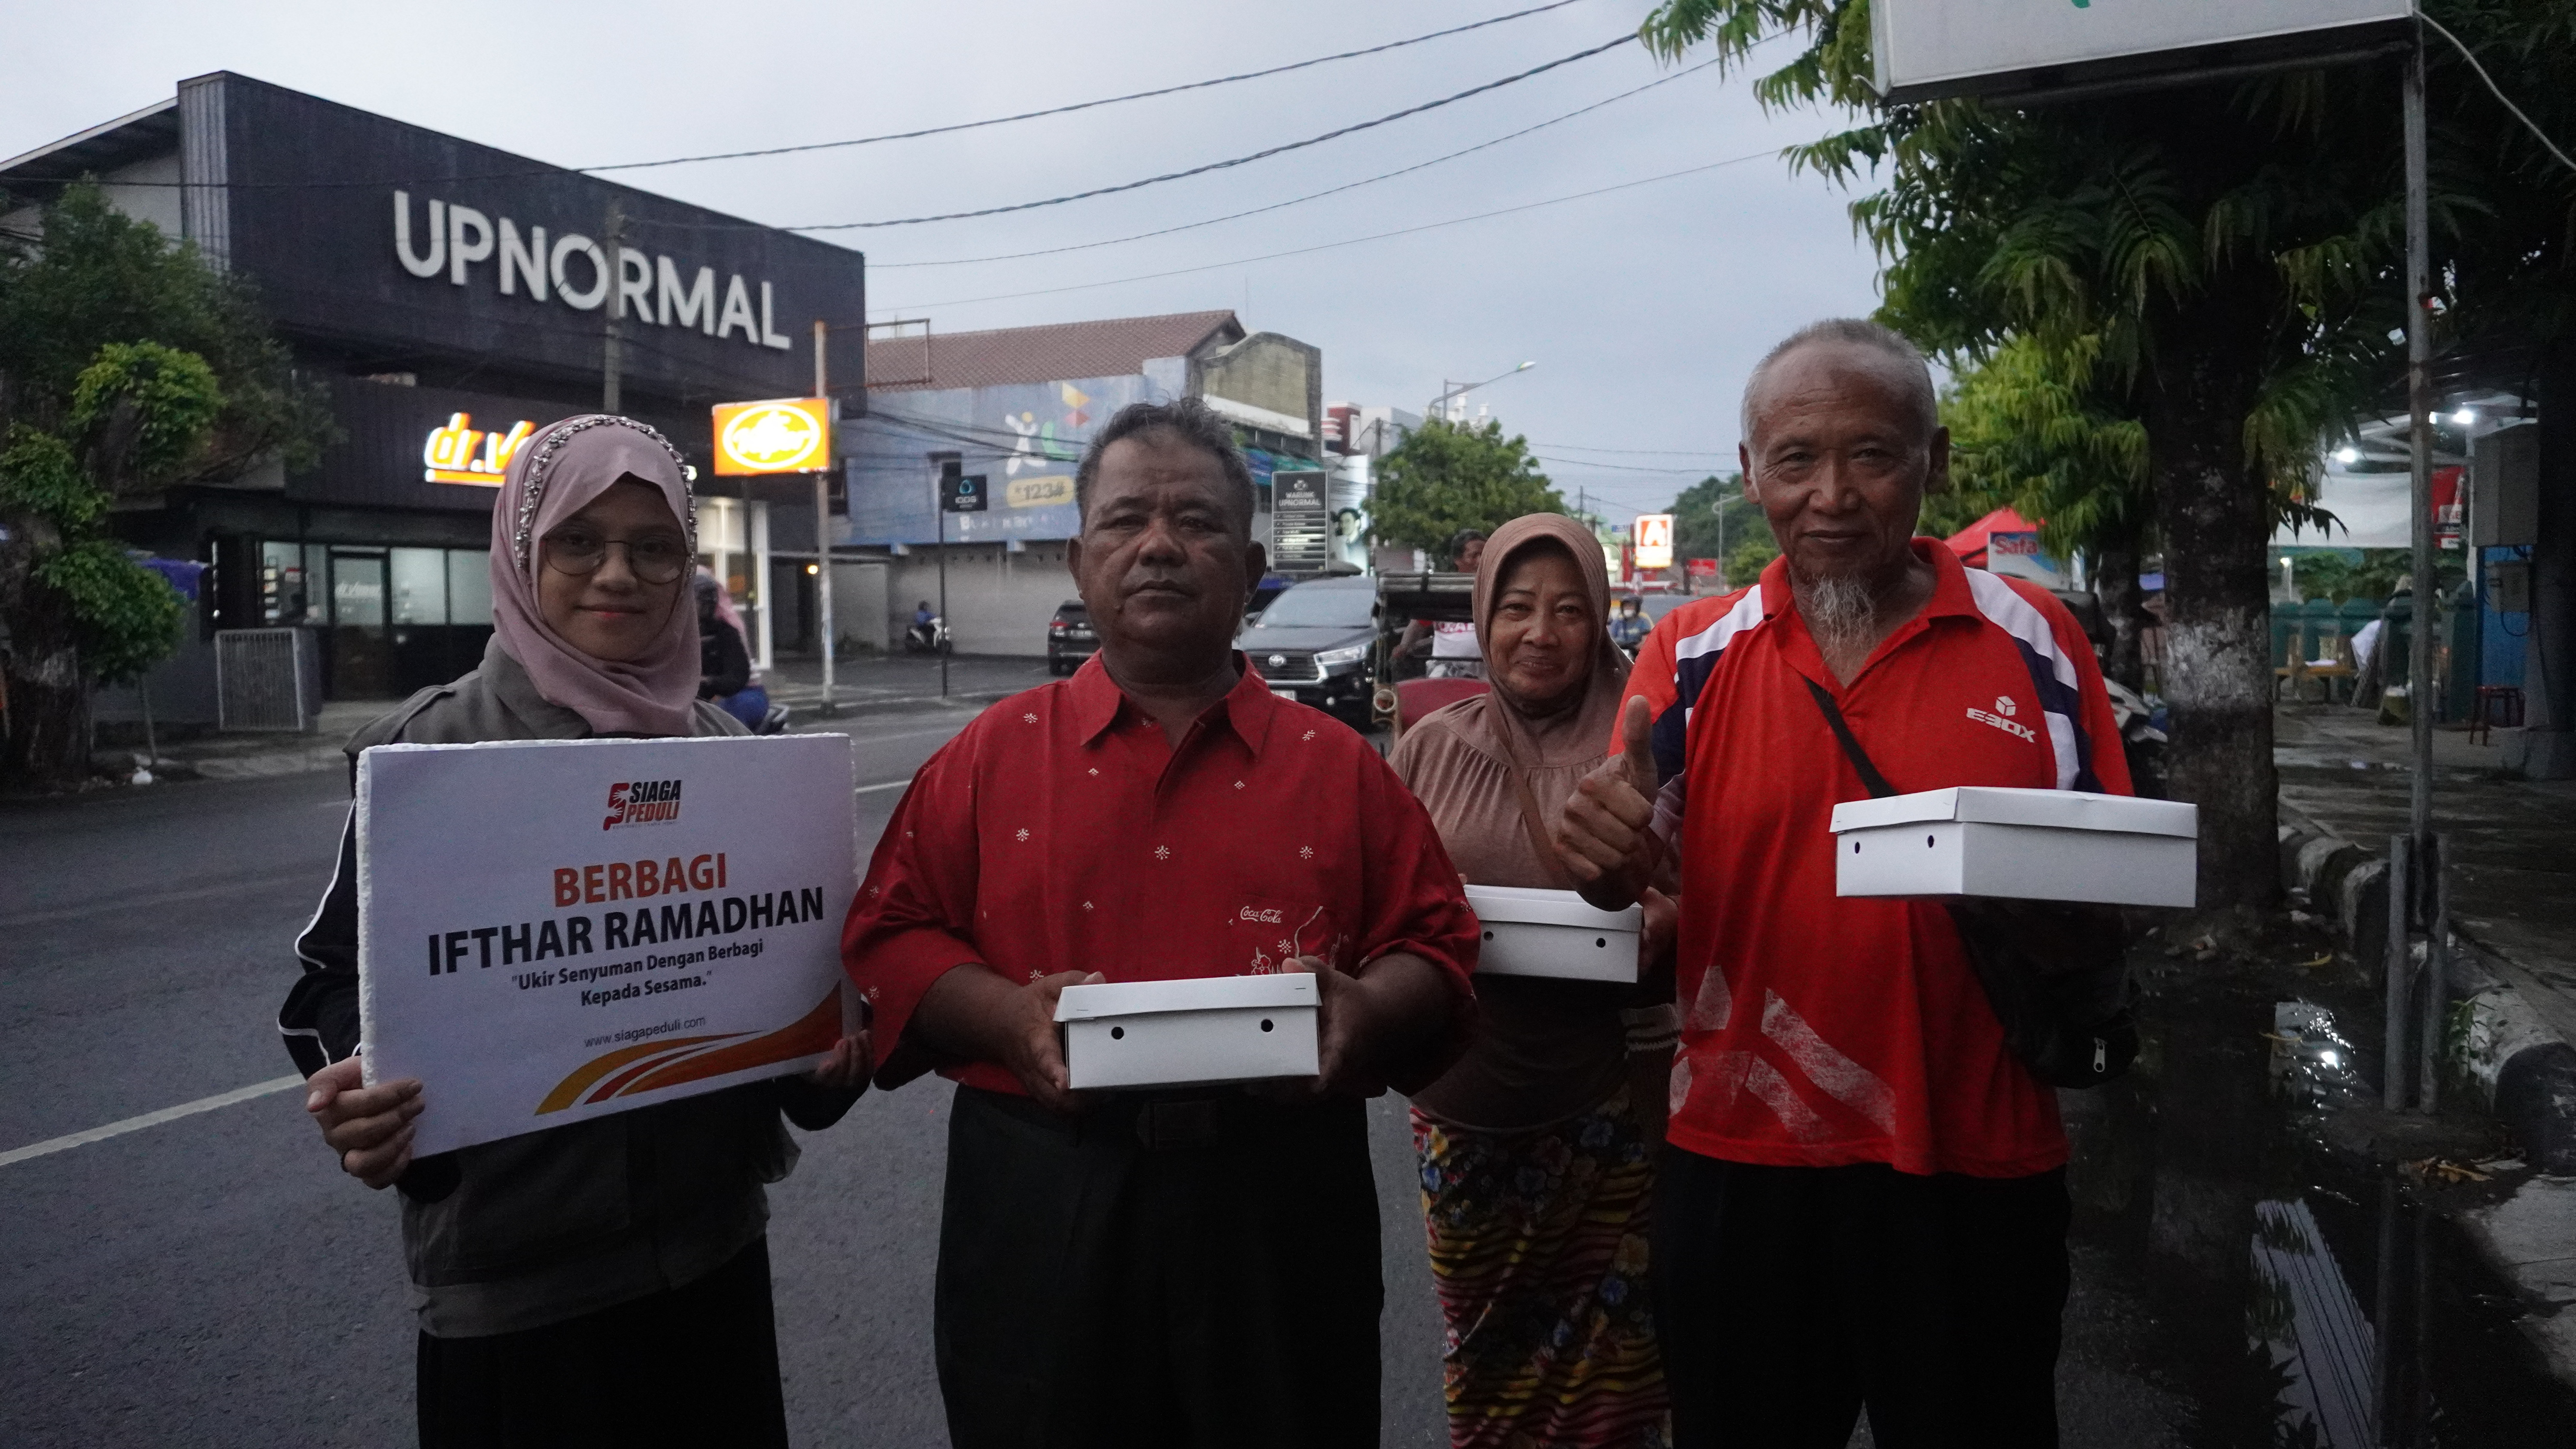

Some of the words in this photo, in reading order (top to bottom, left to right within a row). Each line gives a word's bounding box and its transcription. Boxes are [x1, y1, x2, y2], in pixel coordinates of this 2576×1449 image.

[394, 190, 791, 349] UPNORMAL
[626, 801, 680, 823] PEDULI
[629, 780, 681, 804] SIAGA
[554, 853, 726, 907] BERBAGI
[428, 920, 594, 976] IFTHAR
[605, 886, 823, 951] RAMADHAN
[559, 961, 643, 984] Senyuman
[647, 951, 705, 970] Dengan
[708, 938, 763, 961] Berbagi
[581, 983, 640, 1006] Kepada
[644, 970, 712, 995] Sesama."
[584, 1017, 706, 1047] www.siagapeduli.com
